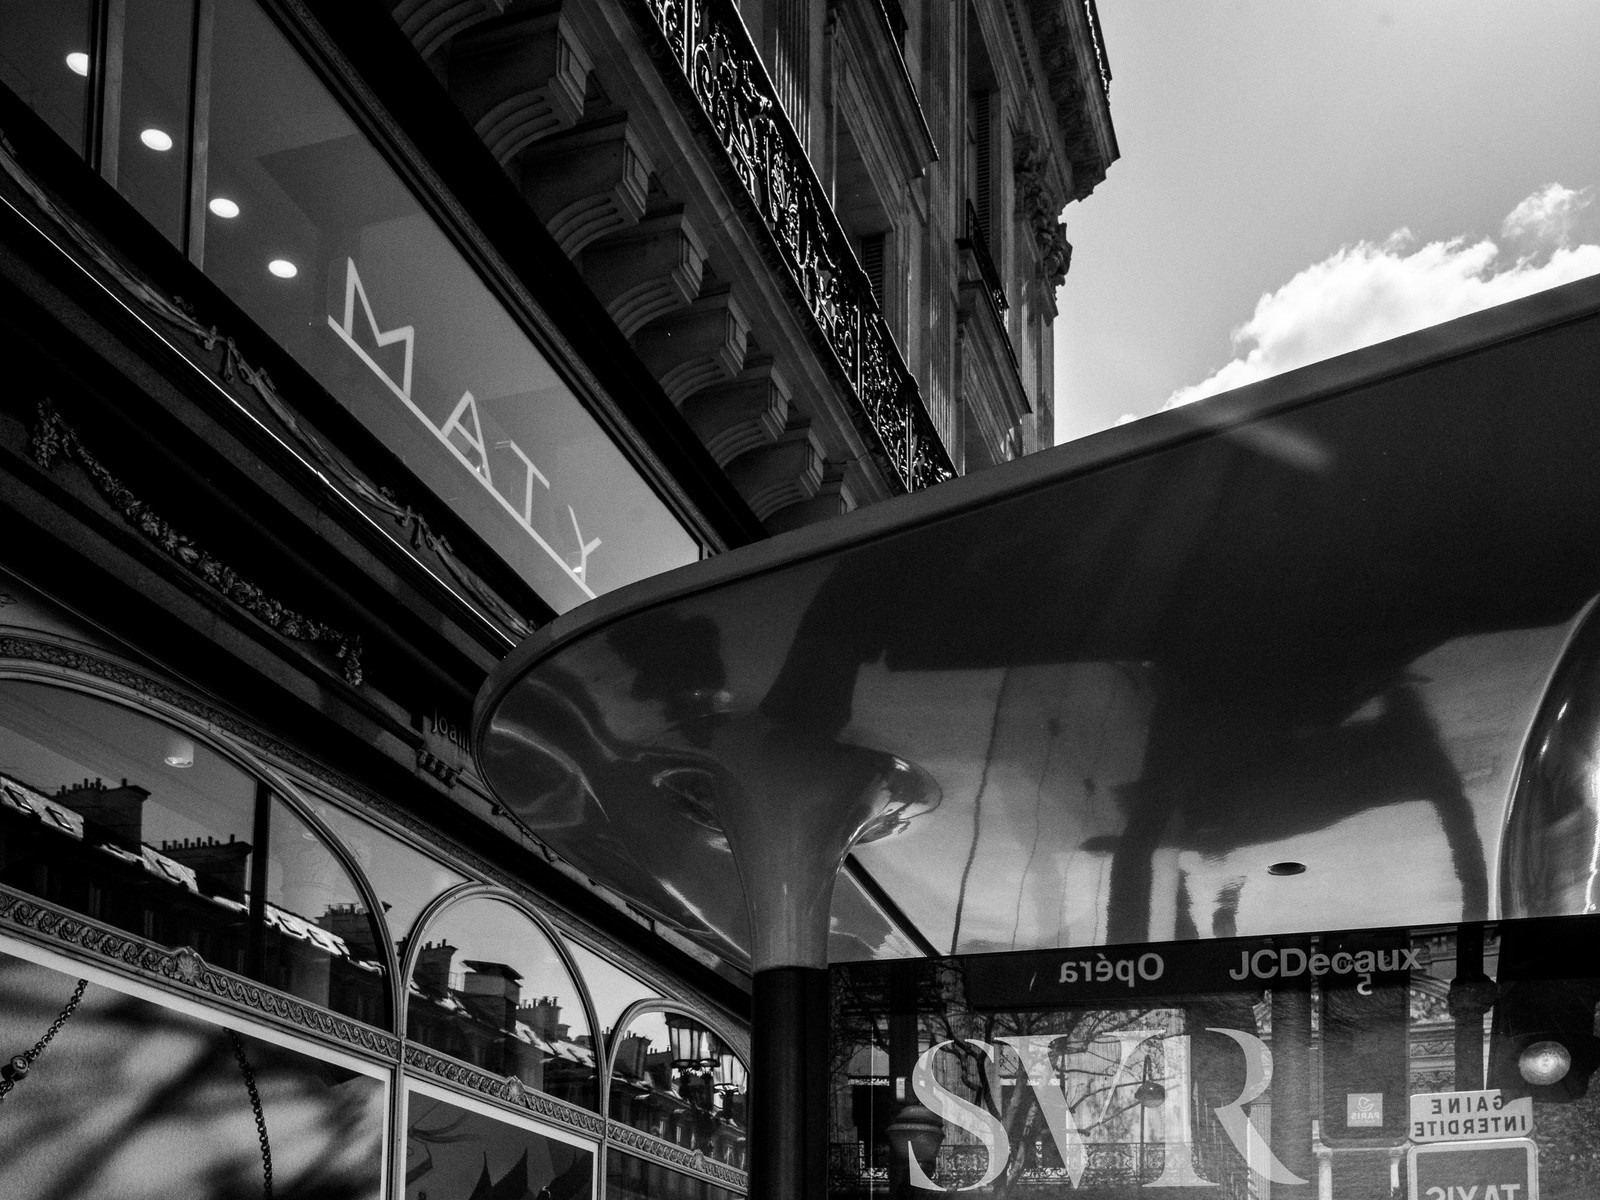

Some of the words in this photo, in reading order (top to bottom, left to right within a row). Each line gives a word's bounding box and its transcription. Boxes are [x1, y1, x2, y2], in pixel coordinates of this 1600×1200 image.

[342, 257, 602, 586] MATY
[431, 705, 470, 752] Joaill
[1229, 946, 1423, 981] JCDecaux
[907, 1027, 1310, 1192] SVR
